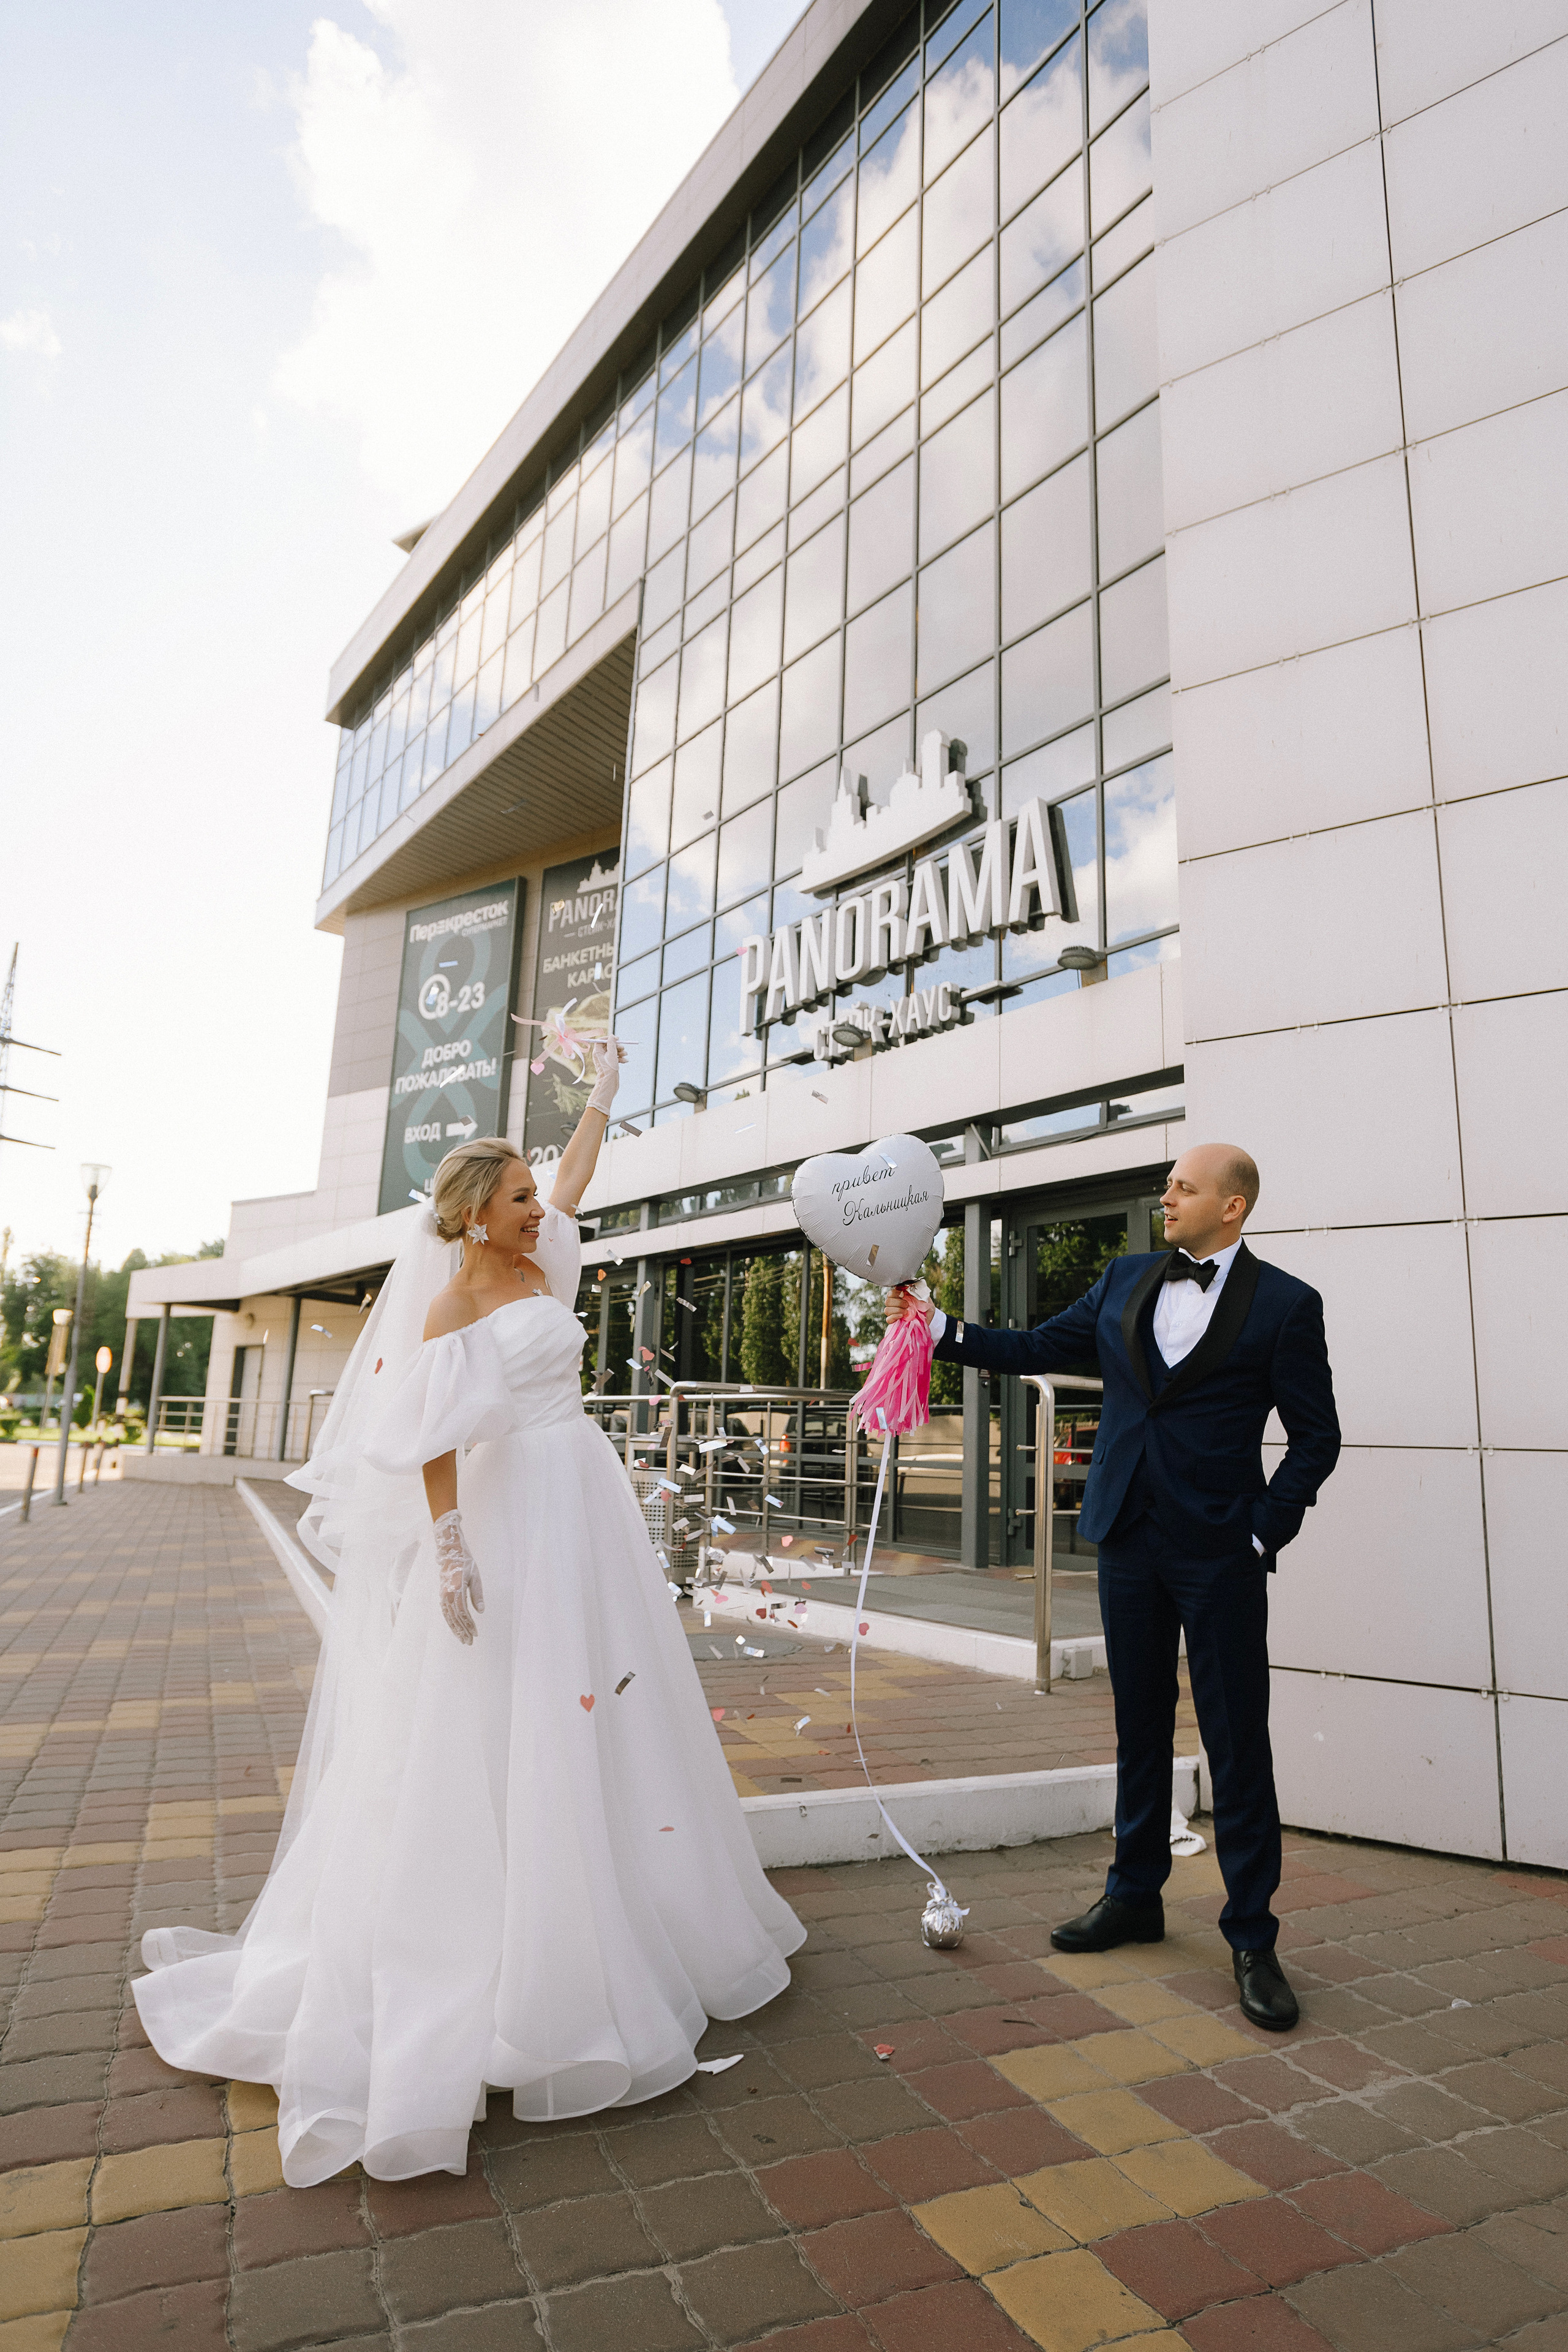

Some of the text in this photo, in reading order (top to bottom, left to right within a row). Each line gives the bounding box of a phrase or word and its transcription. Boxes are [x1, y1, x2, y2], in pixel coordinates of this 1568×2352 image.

[739, 797, 1063, 1036] PANORAMA
[435, 981, 486, 1018] 8-23
[421, 1039, 472, 1069] ДОБРО
[394, 1057, 497, 1095] ПОЖАЛОВАТЬ!
[404, 1122, 442, 1144] ВХОД
[831, 1166, 895, 1202] привет
[842, 1185, 929, 1226] Кальницкая
